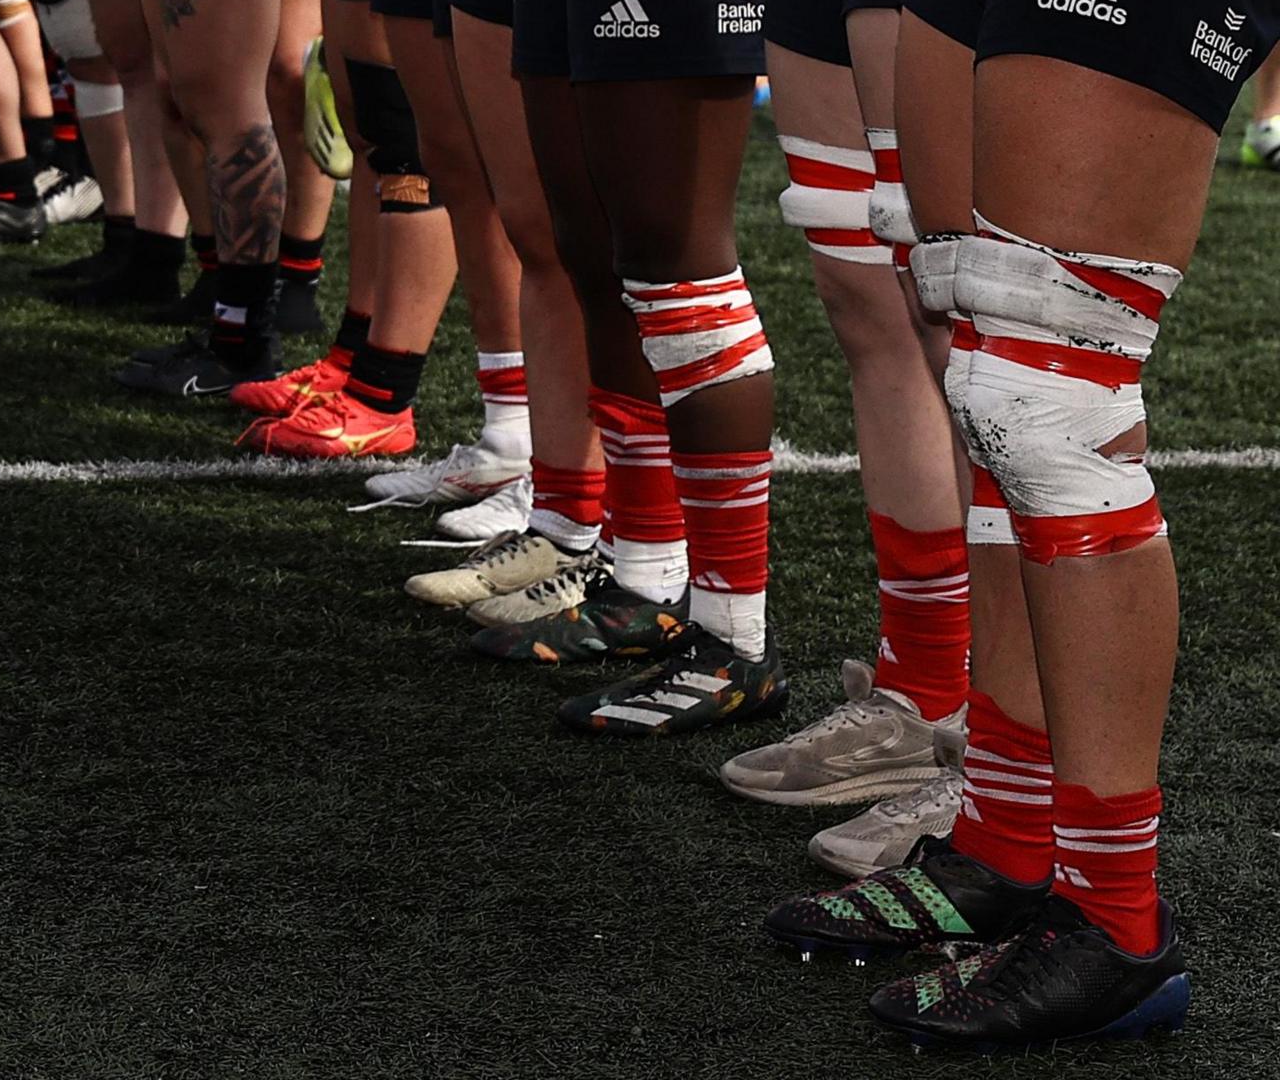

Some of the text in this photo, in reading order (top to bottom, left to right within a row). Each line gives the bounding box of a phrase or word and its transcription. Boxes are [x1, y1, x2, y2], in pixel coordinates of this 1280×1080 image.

[718, 3, 755, 18] Bank
[593, 21, 661, 38] adidas
[718, 18, 762, 33] Irelan
[1195, 20, 1253, 65] Bank of
[1190, 38, 1241, 82] Ireland
